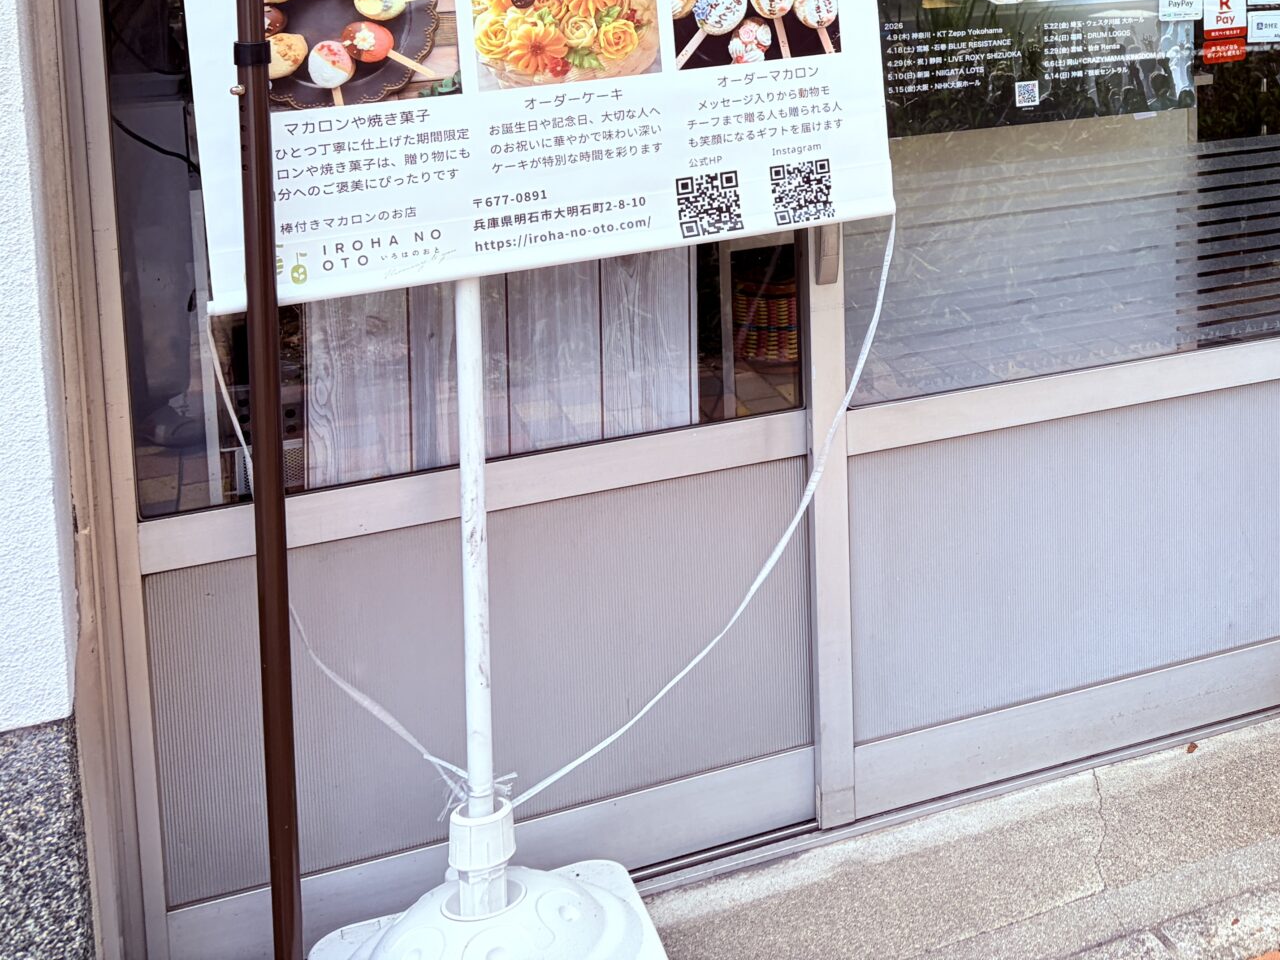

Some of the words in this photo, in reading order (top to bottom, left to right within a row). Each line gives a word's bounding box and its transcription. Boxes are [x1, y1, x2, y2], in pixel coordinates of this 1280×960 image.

[1168, 0, 1194, 8] PayPay
[948, 30, 966, 38] Zepp
[967, 27, 1003, 36] Yokohama
[1216, 15, 1236, 25] Pay
[948, 42, 967, 50] BLUE
[968, 38, 1012, 49] RESISTANCE
[965, 53, 985, 61] ROXY
[717, 66, 819, 88] オーダーマカロン
[966, 66, 985, 74] LOTS
[524, 88, 624, 110] オーダーケーキ
[698, 85, 830, 111] メッセージ入りから動物モ
[284, 108, 430, 136] マカロンや焼き菓子
[489, 107, 662, 136] お誕生日や記念日、大切な人へ
[687, 101, 843, 130] チーフまで贈る人も贈られる人
[275, 128, 470, 160] ひとつ丁寧に仕上げた期間限定
[490, 124, 662, 155] のお祝いに華やかで味わい深い
[688, 118, 844, 148] も笑顔になるギフトを届けます
[491, 142, 663, 174] ケーキが特別な時間を彩ります
[688, 155, 723, 168] 公式HP
[772, 143, 822, 157] Instagram
[277, 147, 471, 180] ロンや焼き菓子は、贈り物にも
[275, 168, 459, 201] 分へのご褒美にぴったりです
[473, 189, 548, 209] 〒677-0891
[280, 206, 417, 235] 棒付きマカロンのお店
[473, 196, 646, 231] 兵庫県明石市大明石町2-8-10
[322, 235, 399, 256] IROHA
[414, 229, 442, 243] NO
[475, 216, 651, 252] https://iroha-no-oto.com/
[322, 255, 369, 271] OTO
[381, 247, 440, 261] いろはのおと
